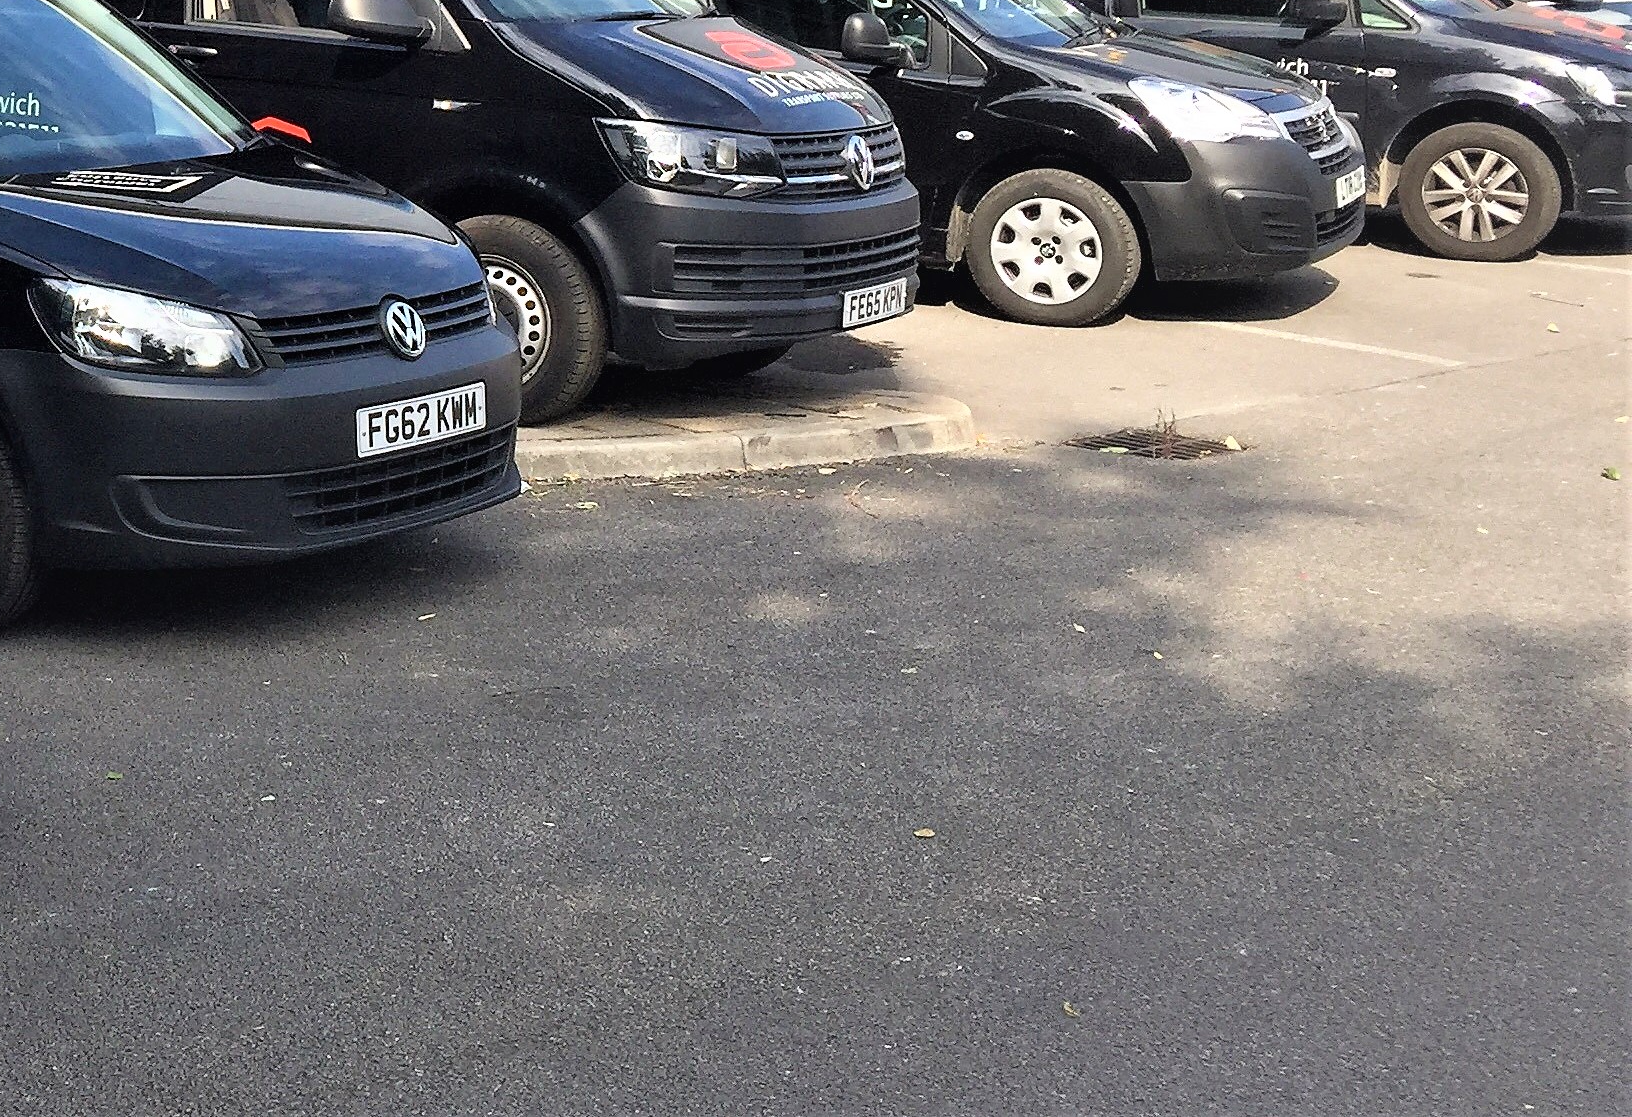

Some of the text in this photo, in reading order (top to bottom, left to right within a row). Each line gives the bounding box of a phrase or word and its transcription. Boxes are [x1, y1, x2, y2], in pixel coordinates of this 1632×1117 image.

[849, 284, 903, 322] FE65 KPN
[367, 391, 477, 448] FG62 KWM
